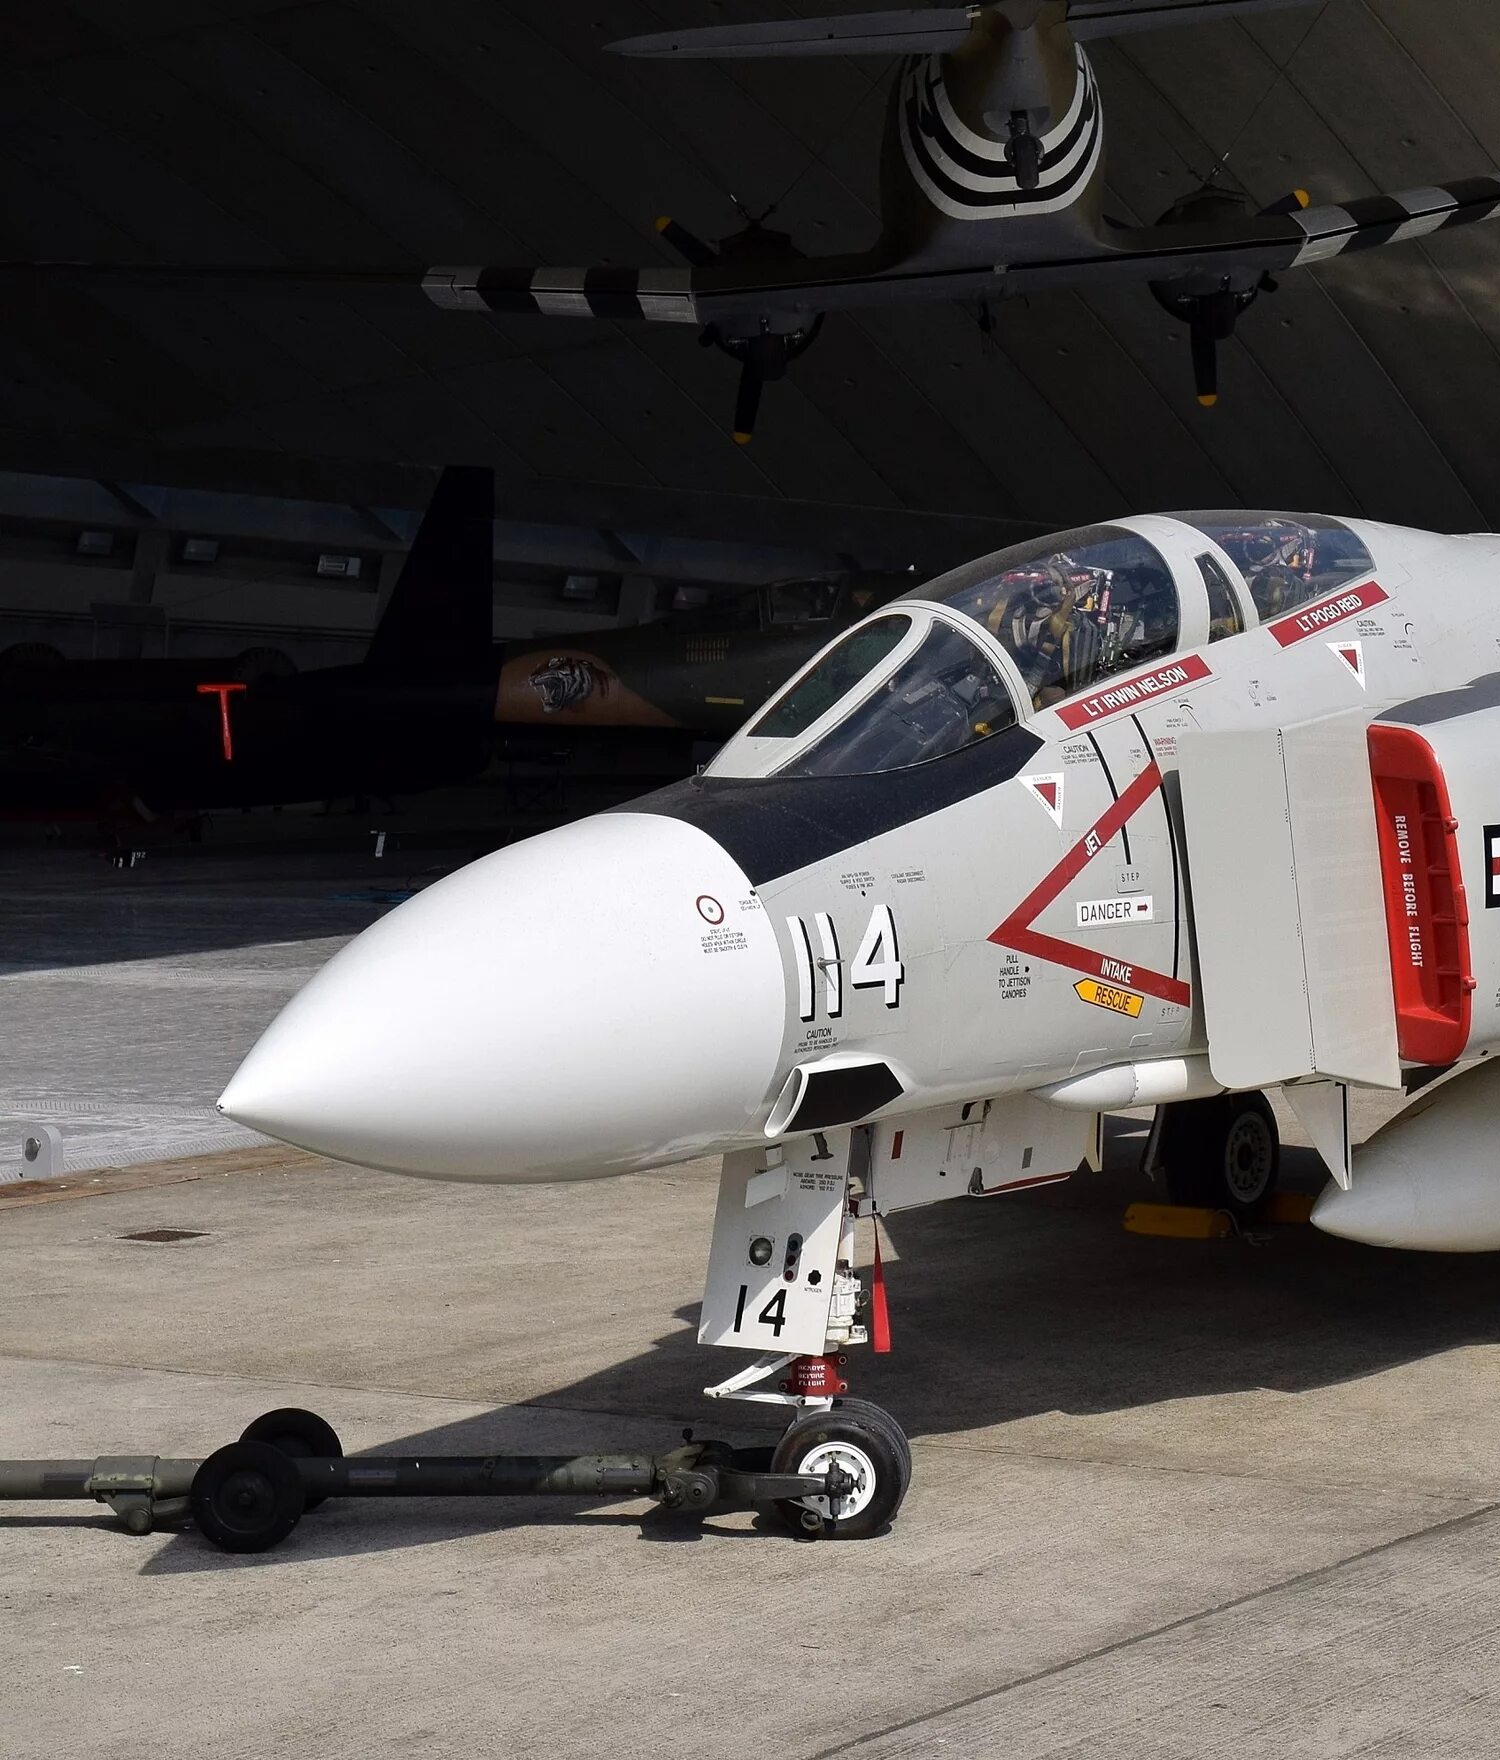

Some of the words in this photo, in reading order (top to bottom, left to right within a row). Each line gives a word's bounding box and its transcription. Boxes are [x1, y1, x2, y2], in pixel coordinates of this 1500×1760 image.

[1296, 617, 1313, 632] LT
[1311, 605, 1342, 624] POGO
[1339, 594, 1363, 614] REID
[1082, 699, 1104, 717] LT
[1101, 684, 1140, 710] IRWIN
[1138, 667, 1188, 695] NELSON
[1063, 744, 1089, 754] CAUTION
[1085, 830, 1102, 857] JET
[1395, 815, 1411, 864] REMOVE
[1121, 872, 1140, 883] STEP
[1402, 873, 1418, 917] BEFORE
[1081, 902, 1131, 922] DANGER
[1006, 954, 1018, 964] PULL
[1408, 926, 1423, 968] FLIGHT
[785, 904, 905, 1023] 114
[1000, 965, 1020, 976] HANDLE
[1101, 958, 1132, 983] INTAKE
[998, 978, 1006, 988] TO
[1006, 976, 1031, 988] JETTISON
[1001, 988, 1027, 1000] CANOPIES
[1094, 986, 1132, 1012] RESCUE
[806, 1027, 832, 1040] CAUTION
[733, 1284, 787, 1337] 14
